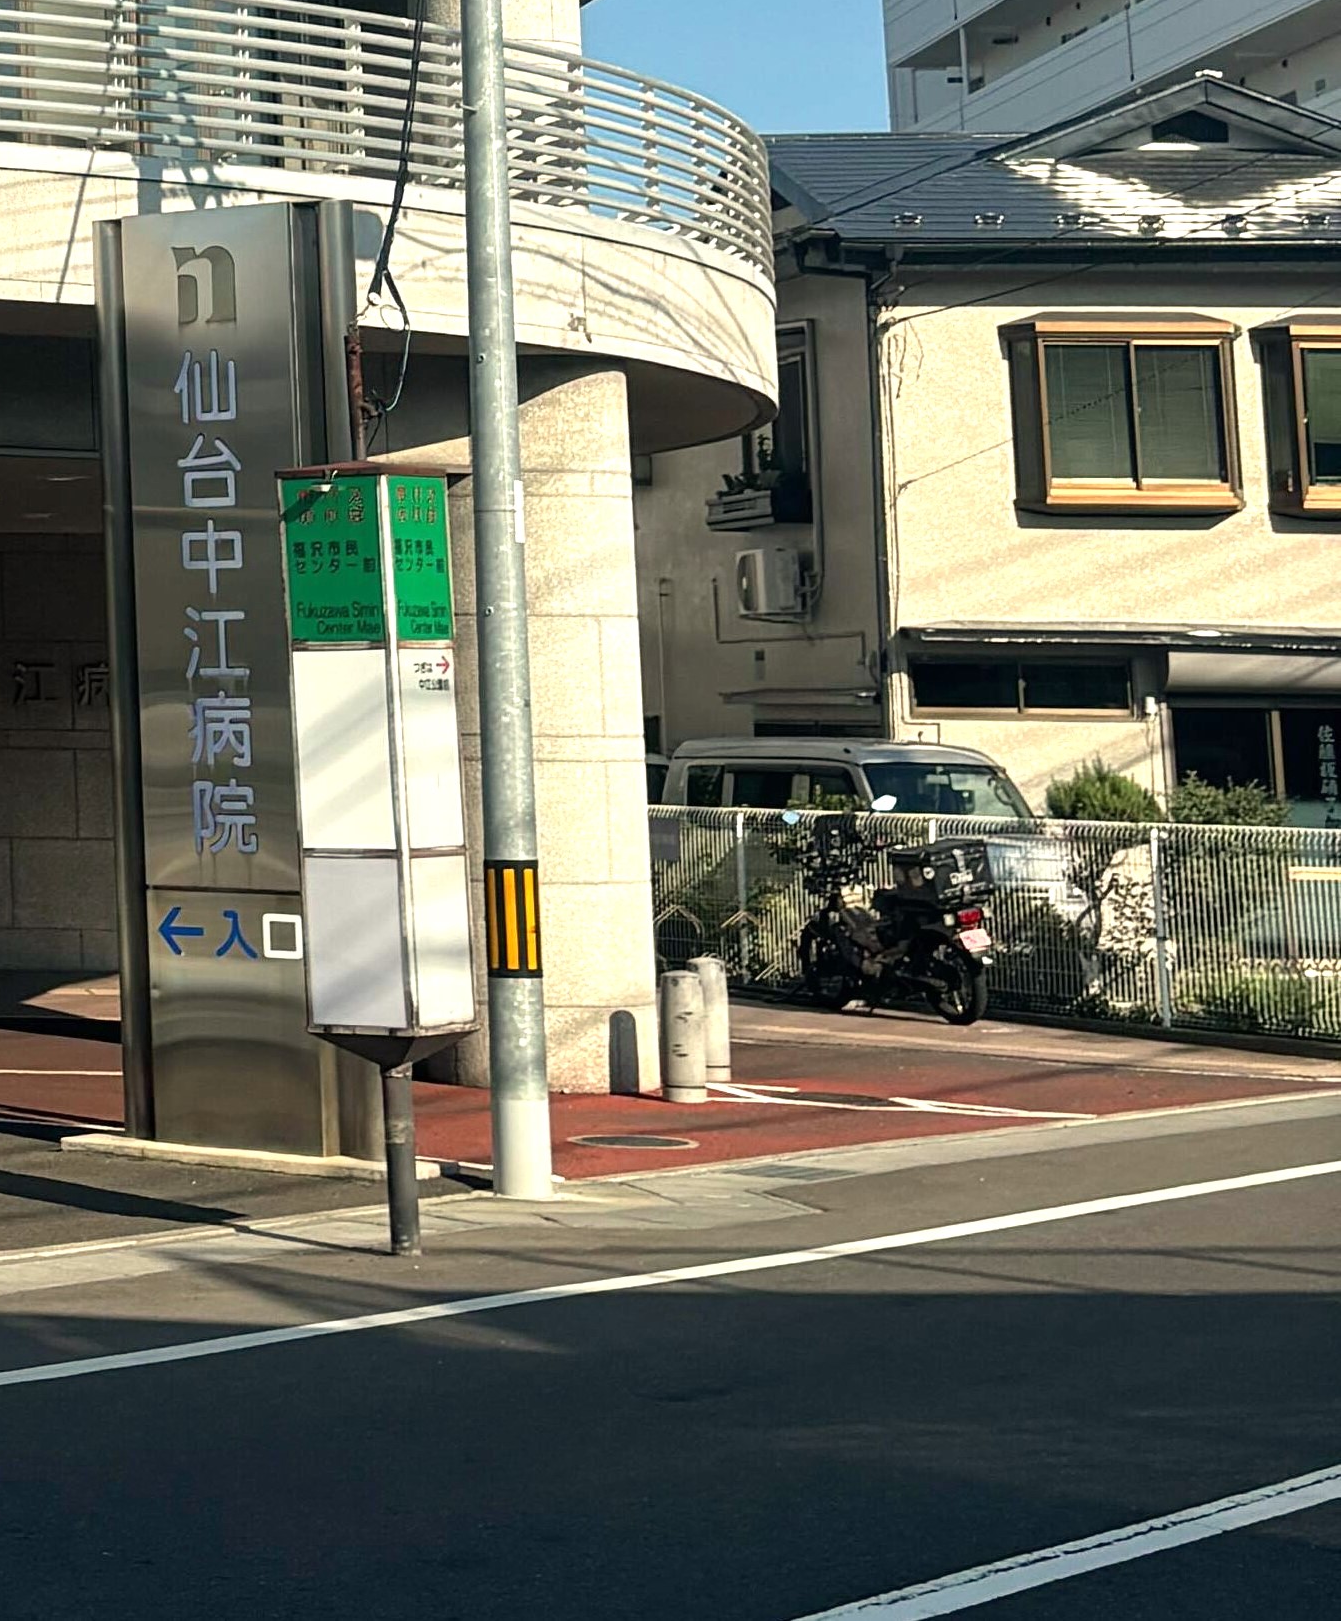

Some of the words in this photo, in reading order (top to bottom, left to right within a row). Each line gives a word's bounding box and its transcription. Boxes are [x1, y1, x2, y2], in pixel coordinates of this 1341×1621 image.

[293, 539, 360, 557] 福沢市民
[294, 557, 377, 574] センター前
[174, 349, 259, 855] 仙台中江病院
[296, 601, 350, 619] Fukuzawa
[318, 620, 353, 635] Center
[356, 620, 381, 635] Mae
[216, 909, 304, 960] 入口
